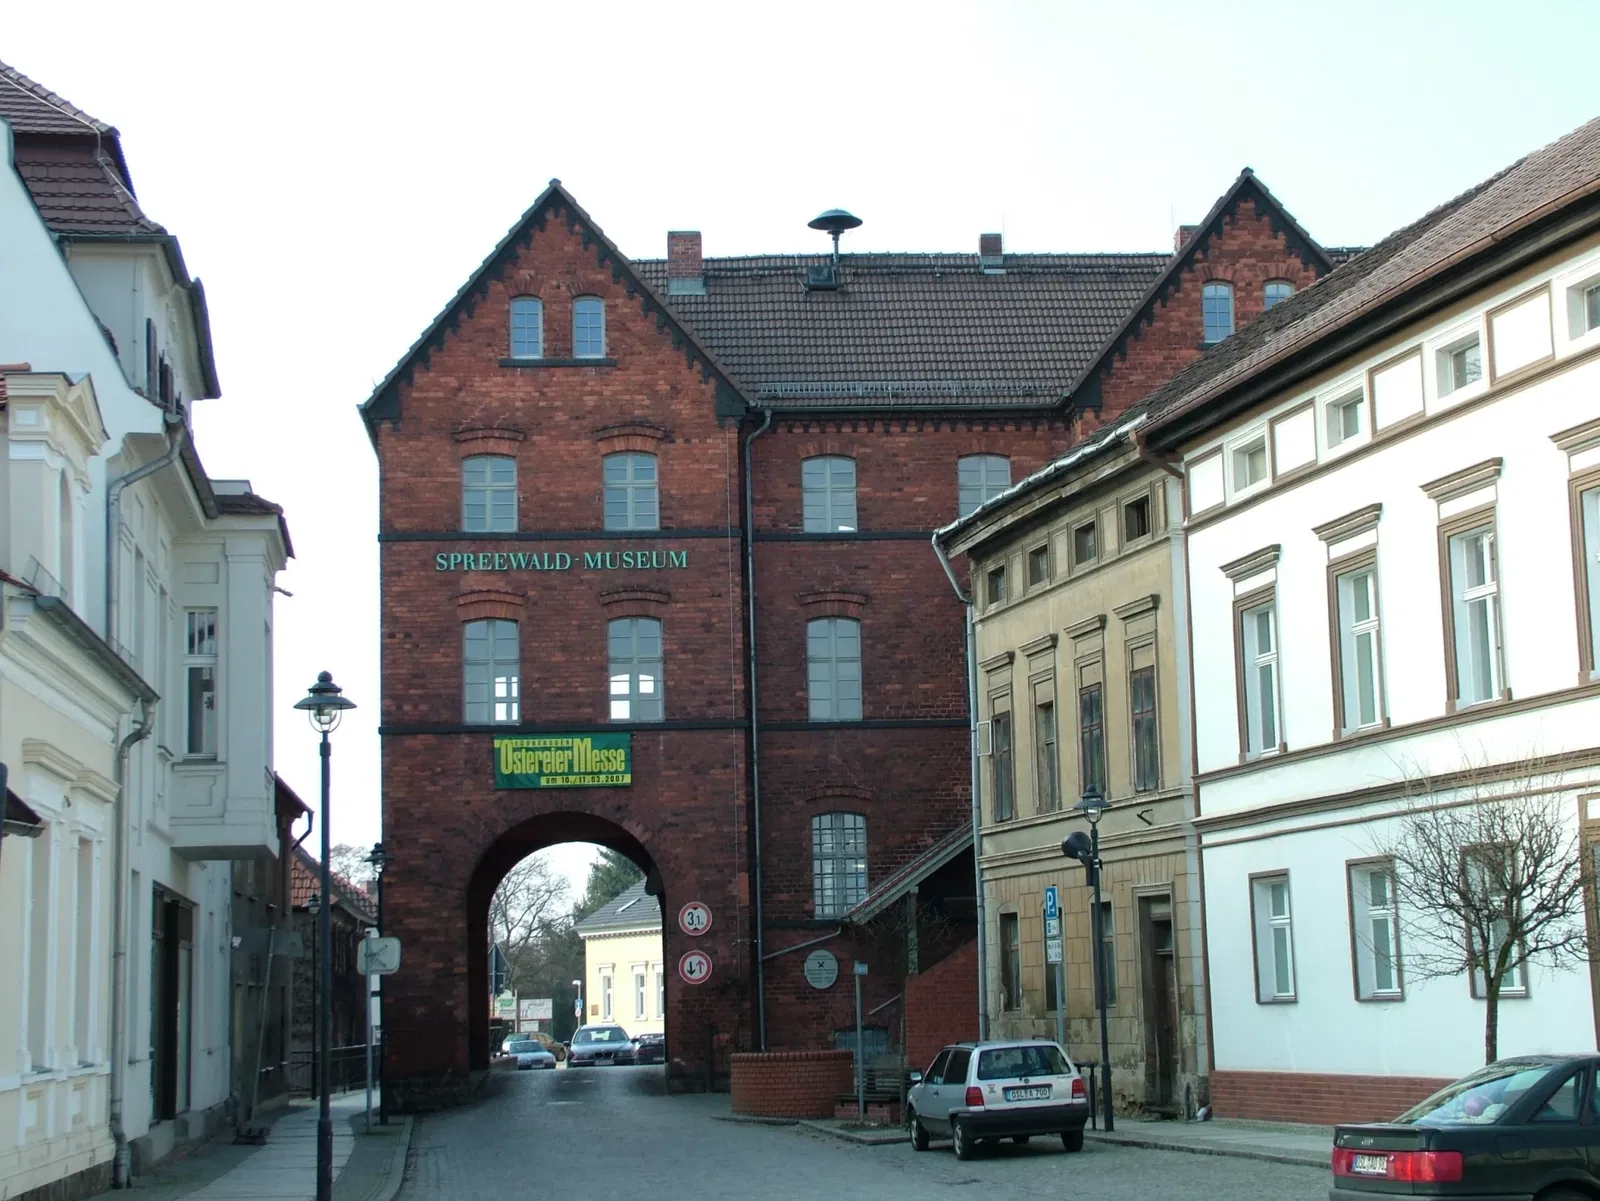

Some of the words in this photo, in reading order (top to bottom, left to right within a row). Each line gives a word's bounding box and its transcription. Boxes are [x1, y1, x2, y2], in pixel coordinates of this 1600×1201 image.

[435, 552, 571, 571] SPREEWALD
[583, 551, 688, 569] MUSEUM
[546, 777, 557, 785] am
